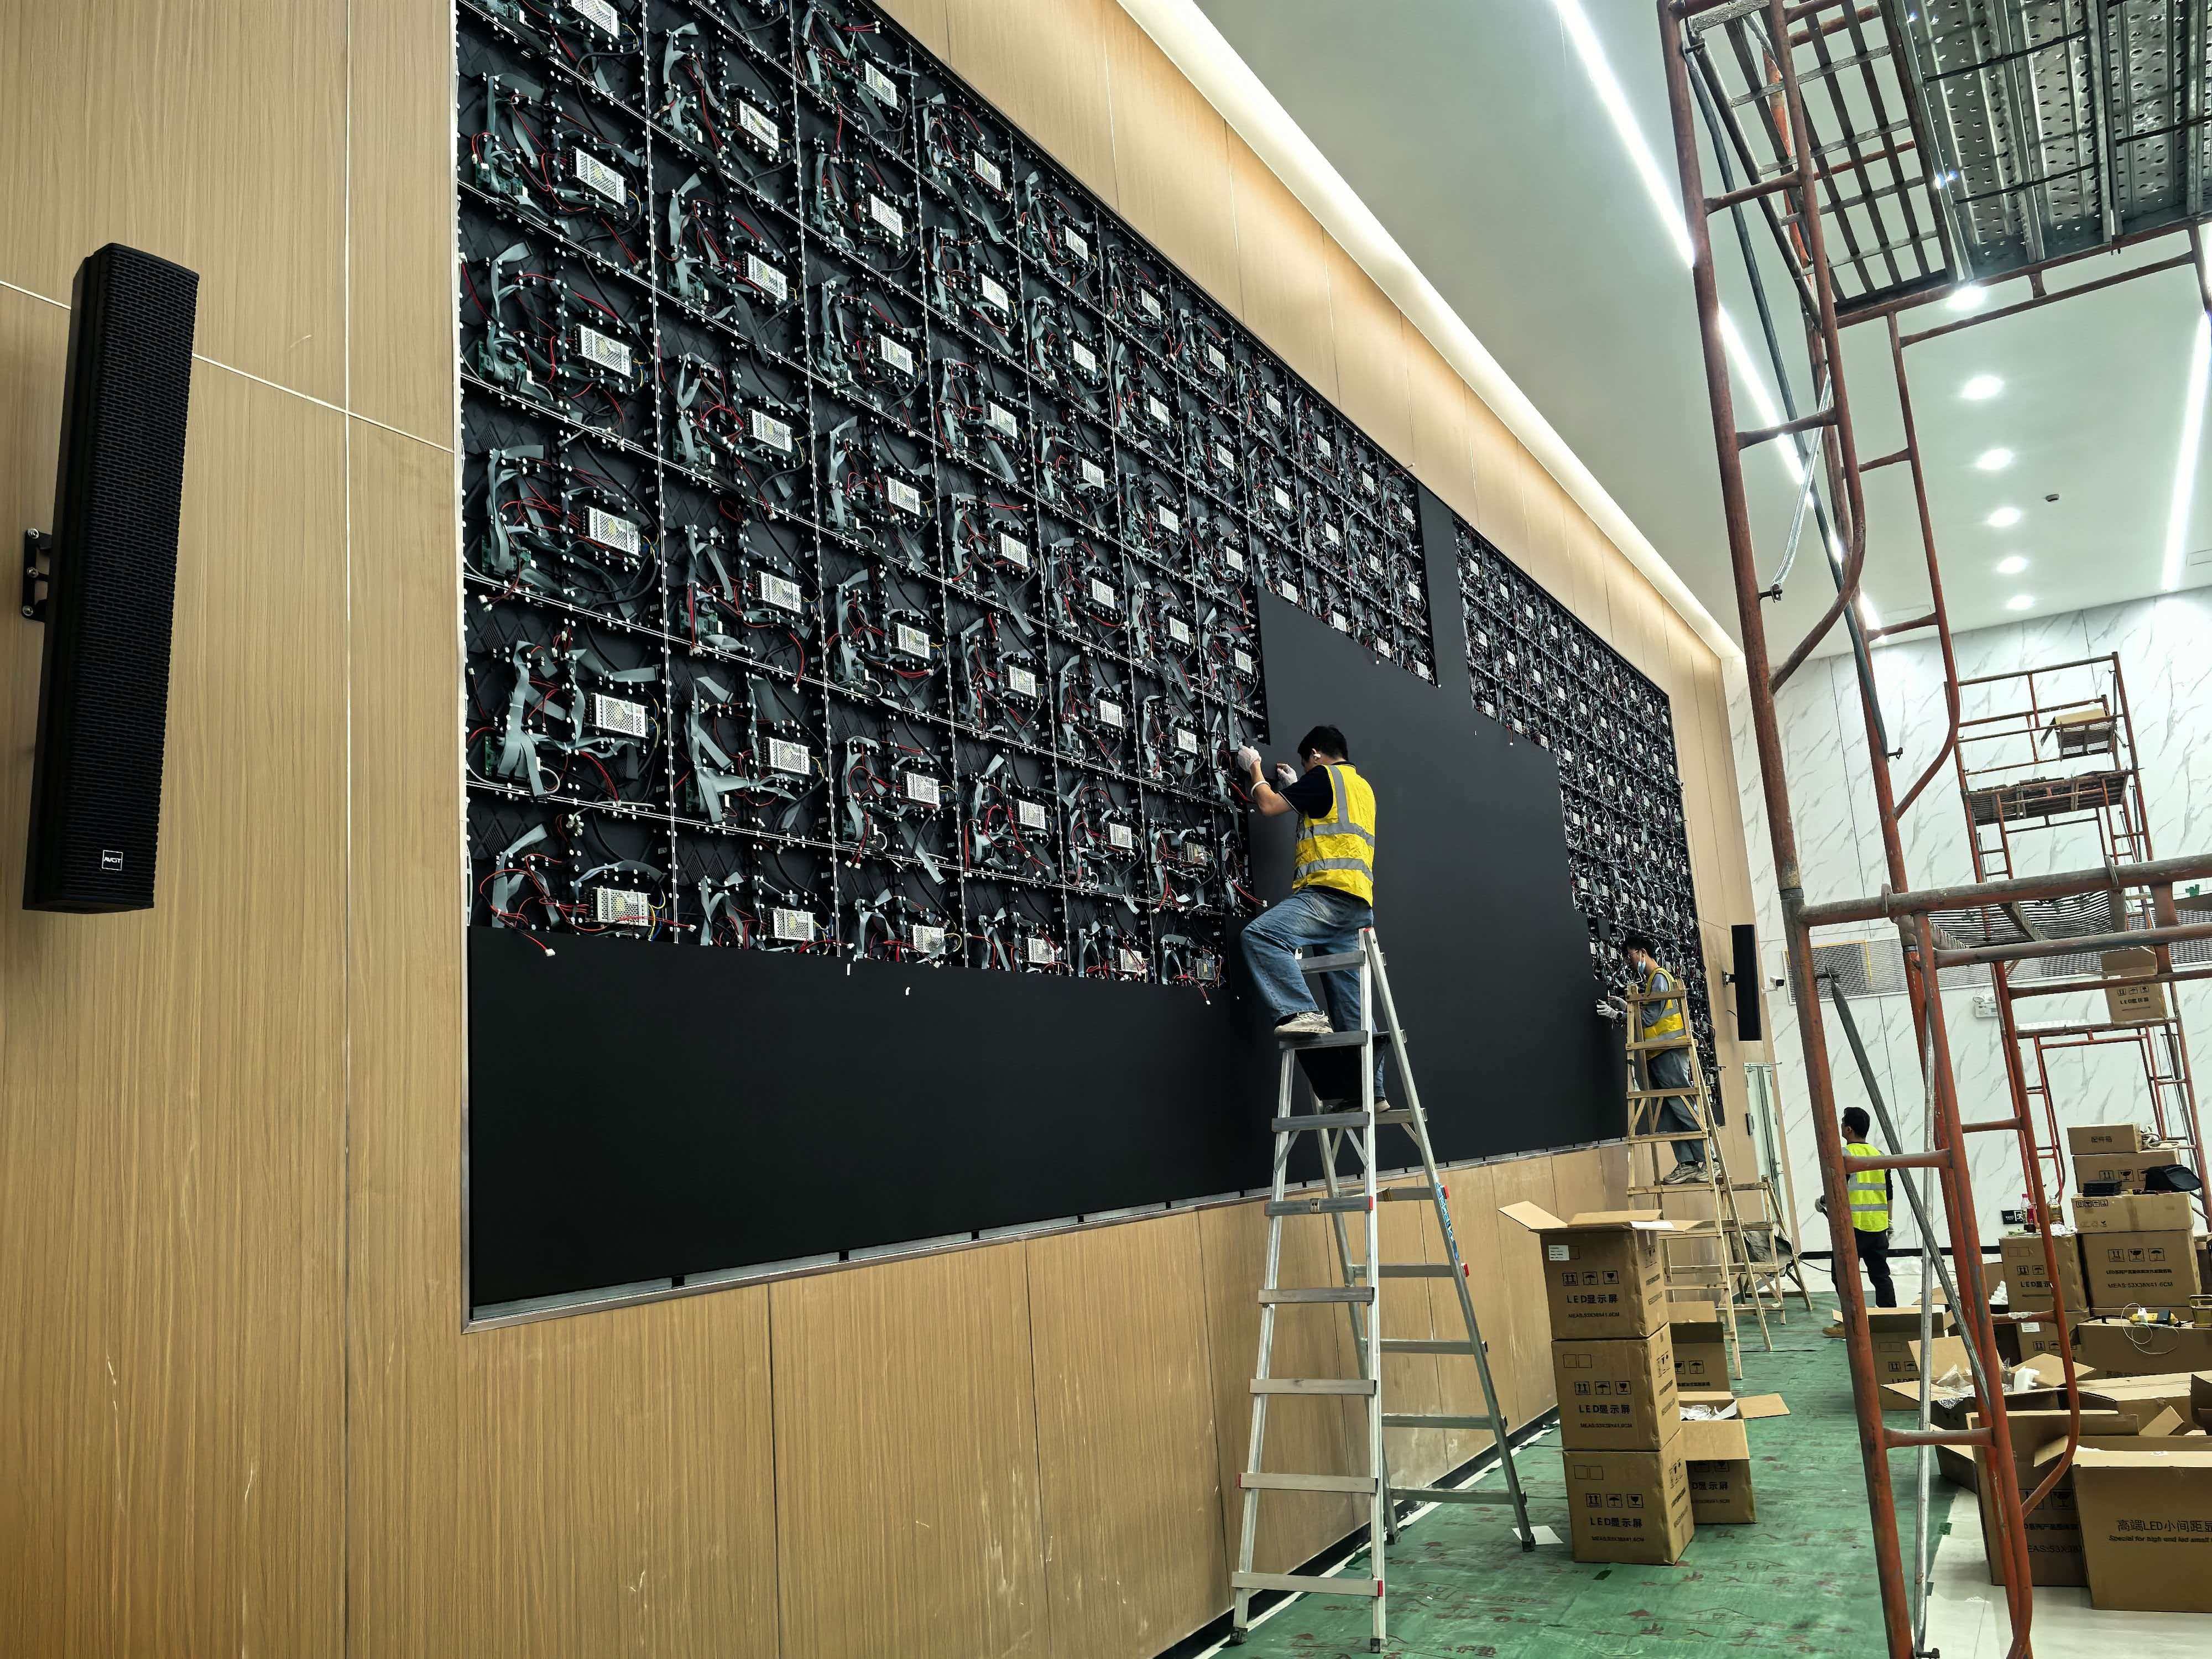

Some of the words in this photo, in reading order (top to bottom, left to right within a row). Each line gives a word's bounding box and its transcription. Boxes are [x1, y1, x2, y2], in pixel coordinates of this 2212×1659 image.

[1567, 1294, 1619, 1304] LED显示屏
[1579, 1405, 1631, 1414] LED显示屏
[1590, 1517, 1642, 1528] LED显示屏
